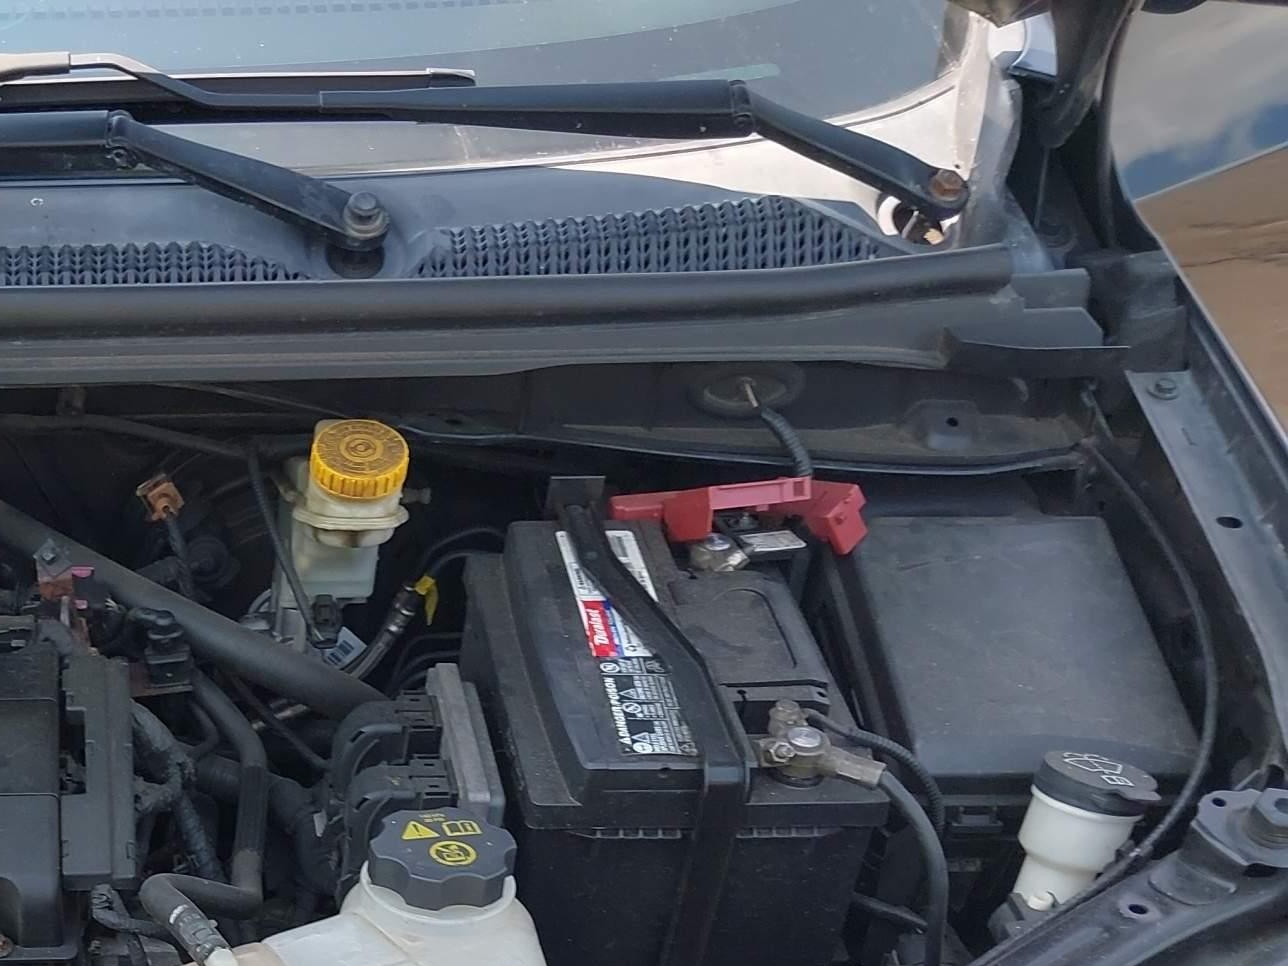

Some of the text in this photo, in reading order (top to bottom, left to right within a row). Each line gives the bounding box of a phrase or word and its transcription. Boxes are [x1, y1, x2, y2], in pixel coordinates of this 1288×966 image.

[585, 608, 610, 646] Duralast
[603, 677, 631, 738] DANGER POISON
